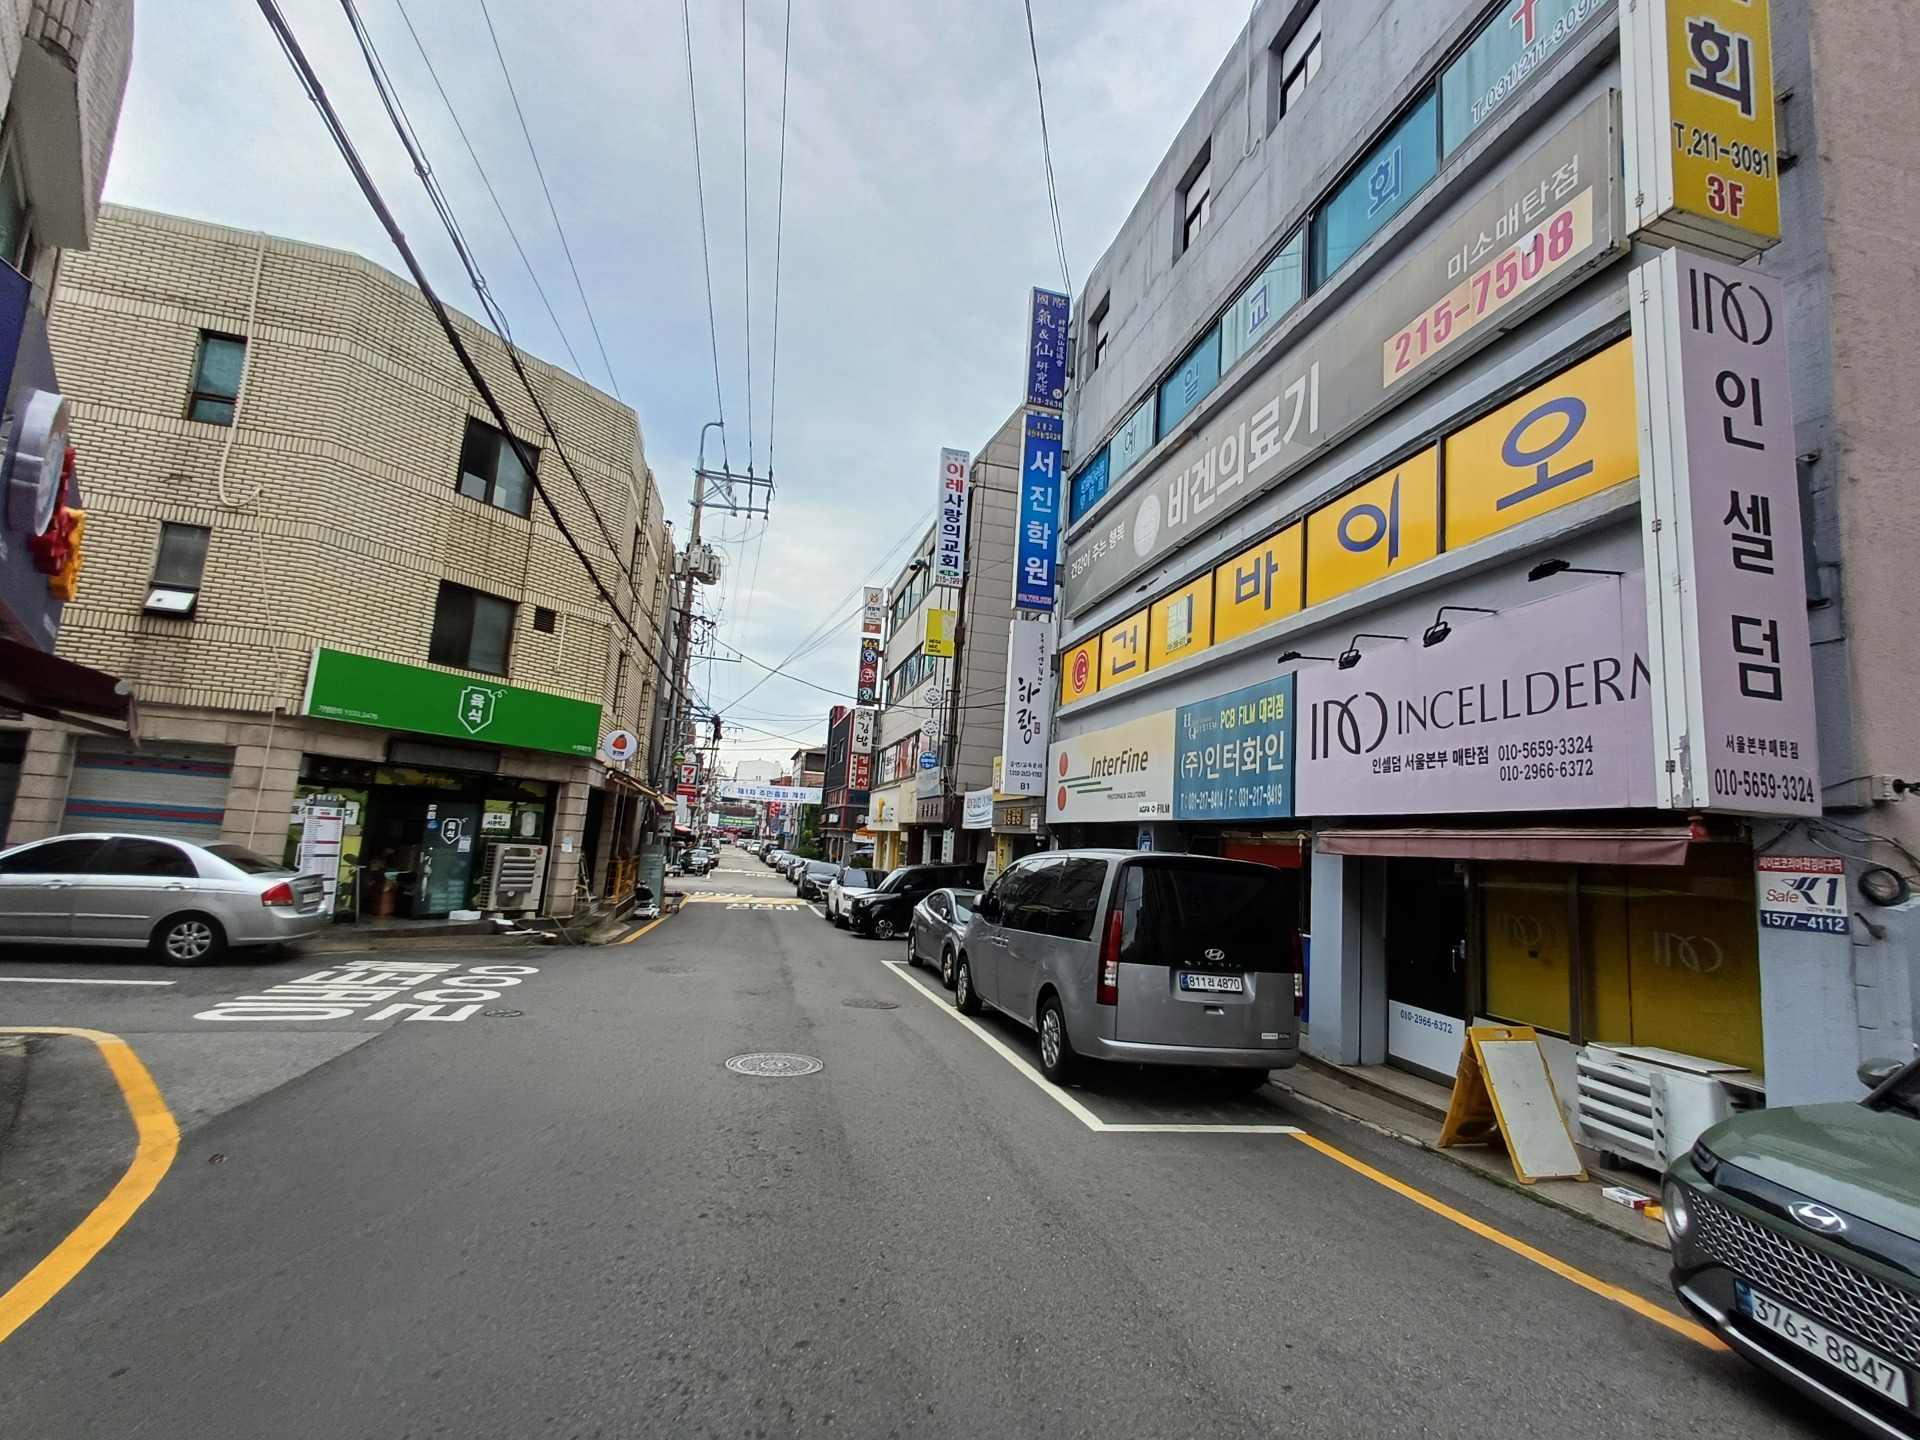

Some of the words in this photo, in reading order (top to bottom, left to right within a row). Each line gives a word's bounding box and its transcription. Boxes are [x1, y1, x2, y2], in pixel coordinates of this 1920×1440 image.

[1673, 122, 1770, 180] T.211-3091
[1706, 175, 1743, 218] 3F
[1394, 210, 1574, 374] 215-7508
[1092, 538, 1108, 561] 주는
[1108, 521, 1126, 550] 행복
[1167, 360, 1320, 529] 비겐의료기
[1447, 153, 1579, 280] 미소매탄점
[1024, 450, 1056, 587] 서진학원
[1220, 707, 1236, 730] PCB
[1237, 701, 1256, 727] FILM
[1258, 693, 1284, 724] 대리점
[856, 721, 869, 747] 김밥
[1090, 748, 1150, 779] InterFine
[1180, 730, 1285, 780] (주)인터화인
[1372, 757, 1402, 775] 인셀덤
[1404, 751, 1449, 772] 서울본부
[1452, 745, 1490, 767] 매탄점
[1497, 734, 1594, 762] 010-5659-3324
[1499, 758, 1594, 782] 010-2966-6372
[1020, 782, 1030, 791] B1
[1714, 767, 1815, 804] 010-5659-3324
[1765, 888, 1800, 904] Safe
[1763, 912, 1846, 932] 1577-4112
[1217, 977, 1240, 990] 4870
[1399, 1009, 1453, 1034] 010-2966-6372
[1752, 1295, 1819, 1348] 376수
[1825, 1333, 1897, 1393] 8847
